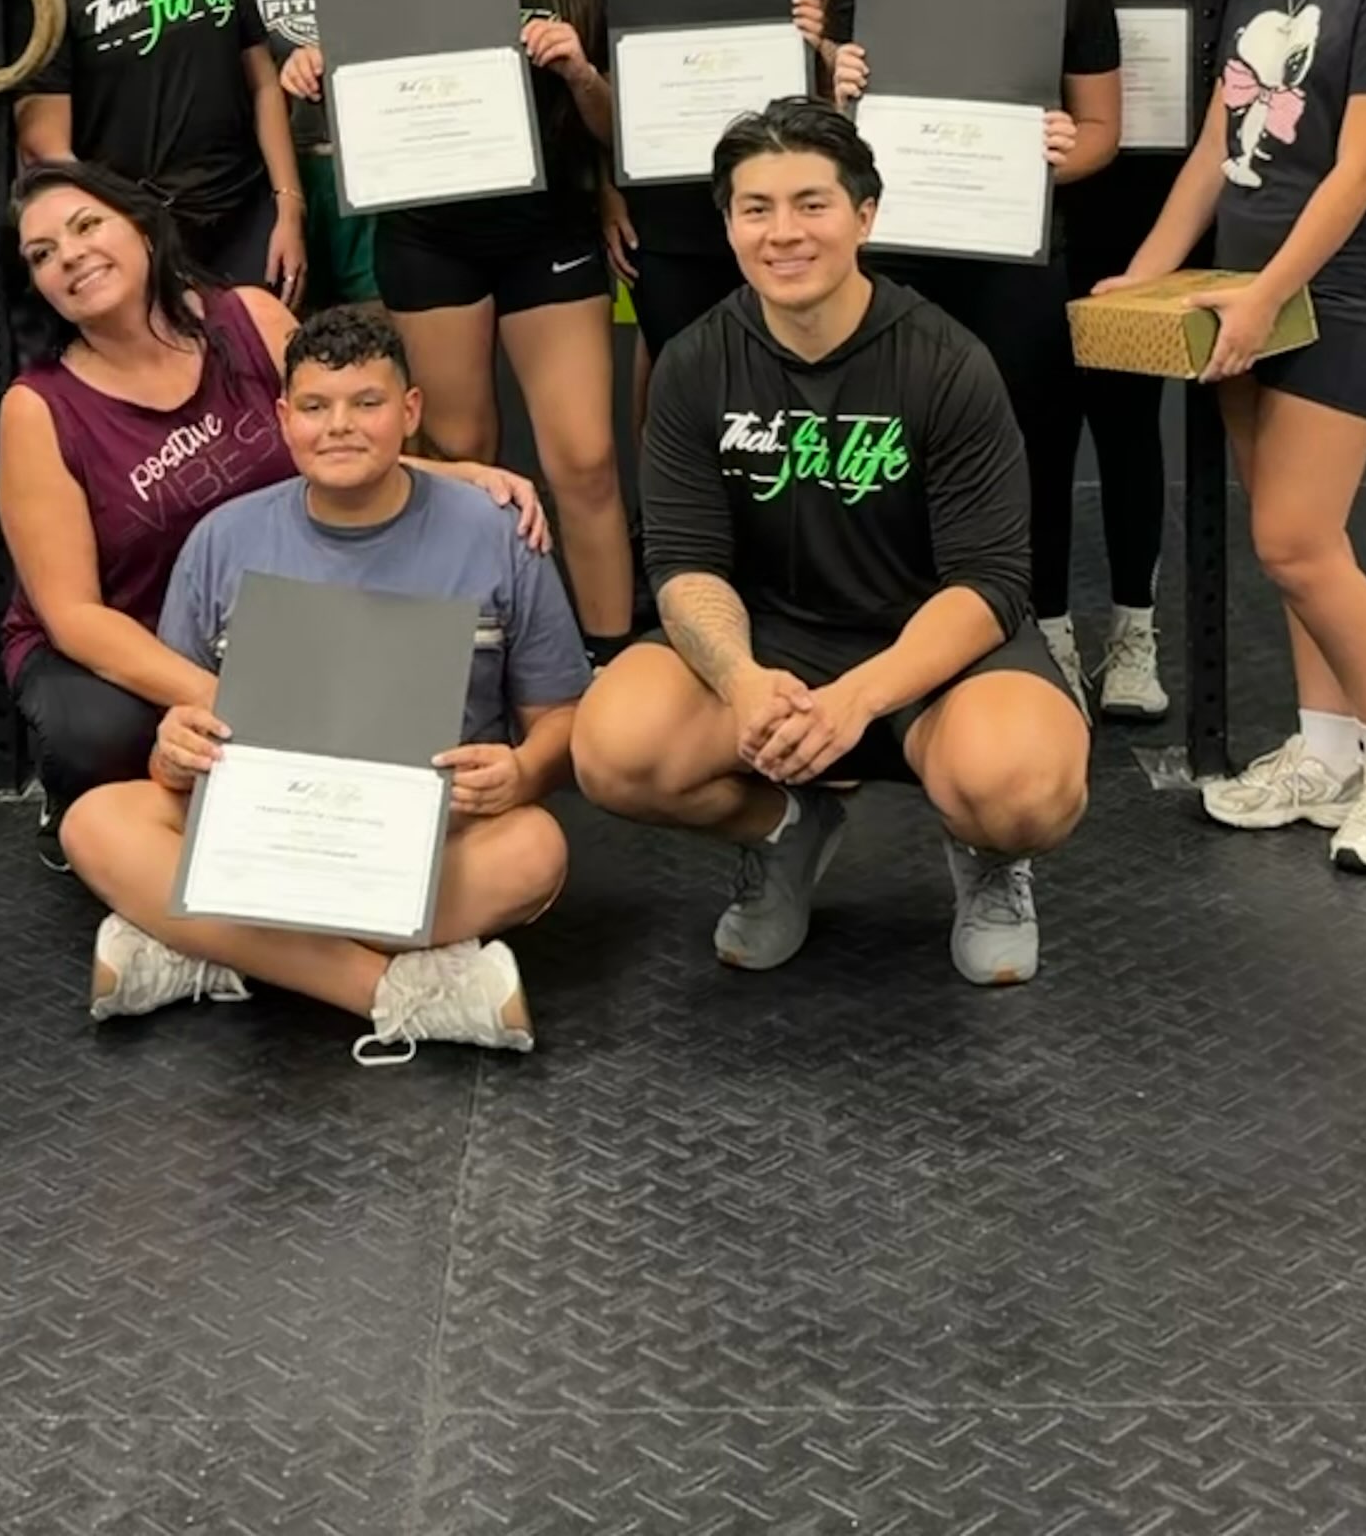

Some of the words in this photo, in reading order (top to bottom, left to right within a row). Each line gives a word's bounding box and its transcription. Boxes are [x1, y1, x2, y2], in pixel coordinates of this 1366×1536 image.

[125, 408, 279, 532] VIBES
[129, 413, 223, 503] positive
[719, 409, 788, 454] That
[752, 415, 830, 502] fit
[836, 415, 910, 506] life
